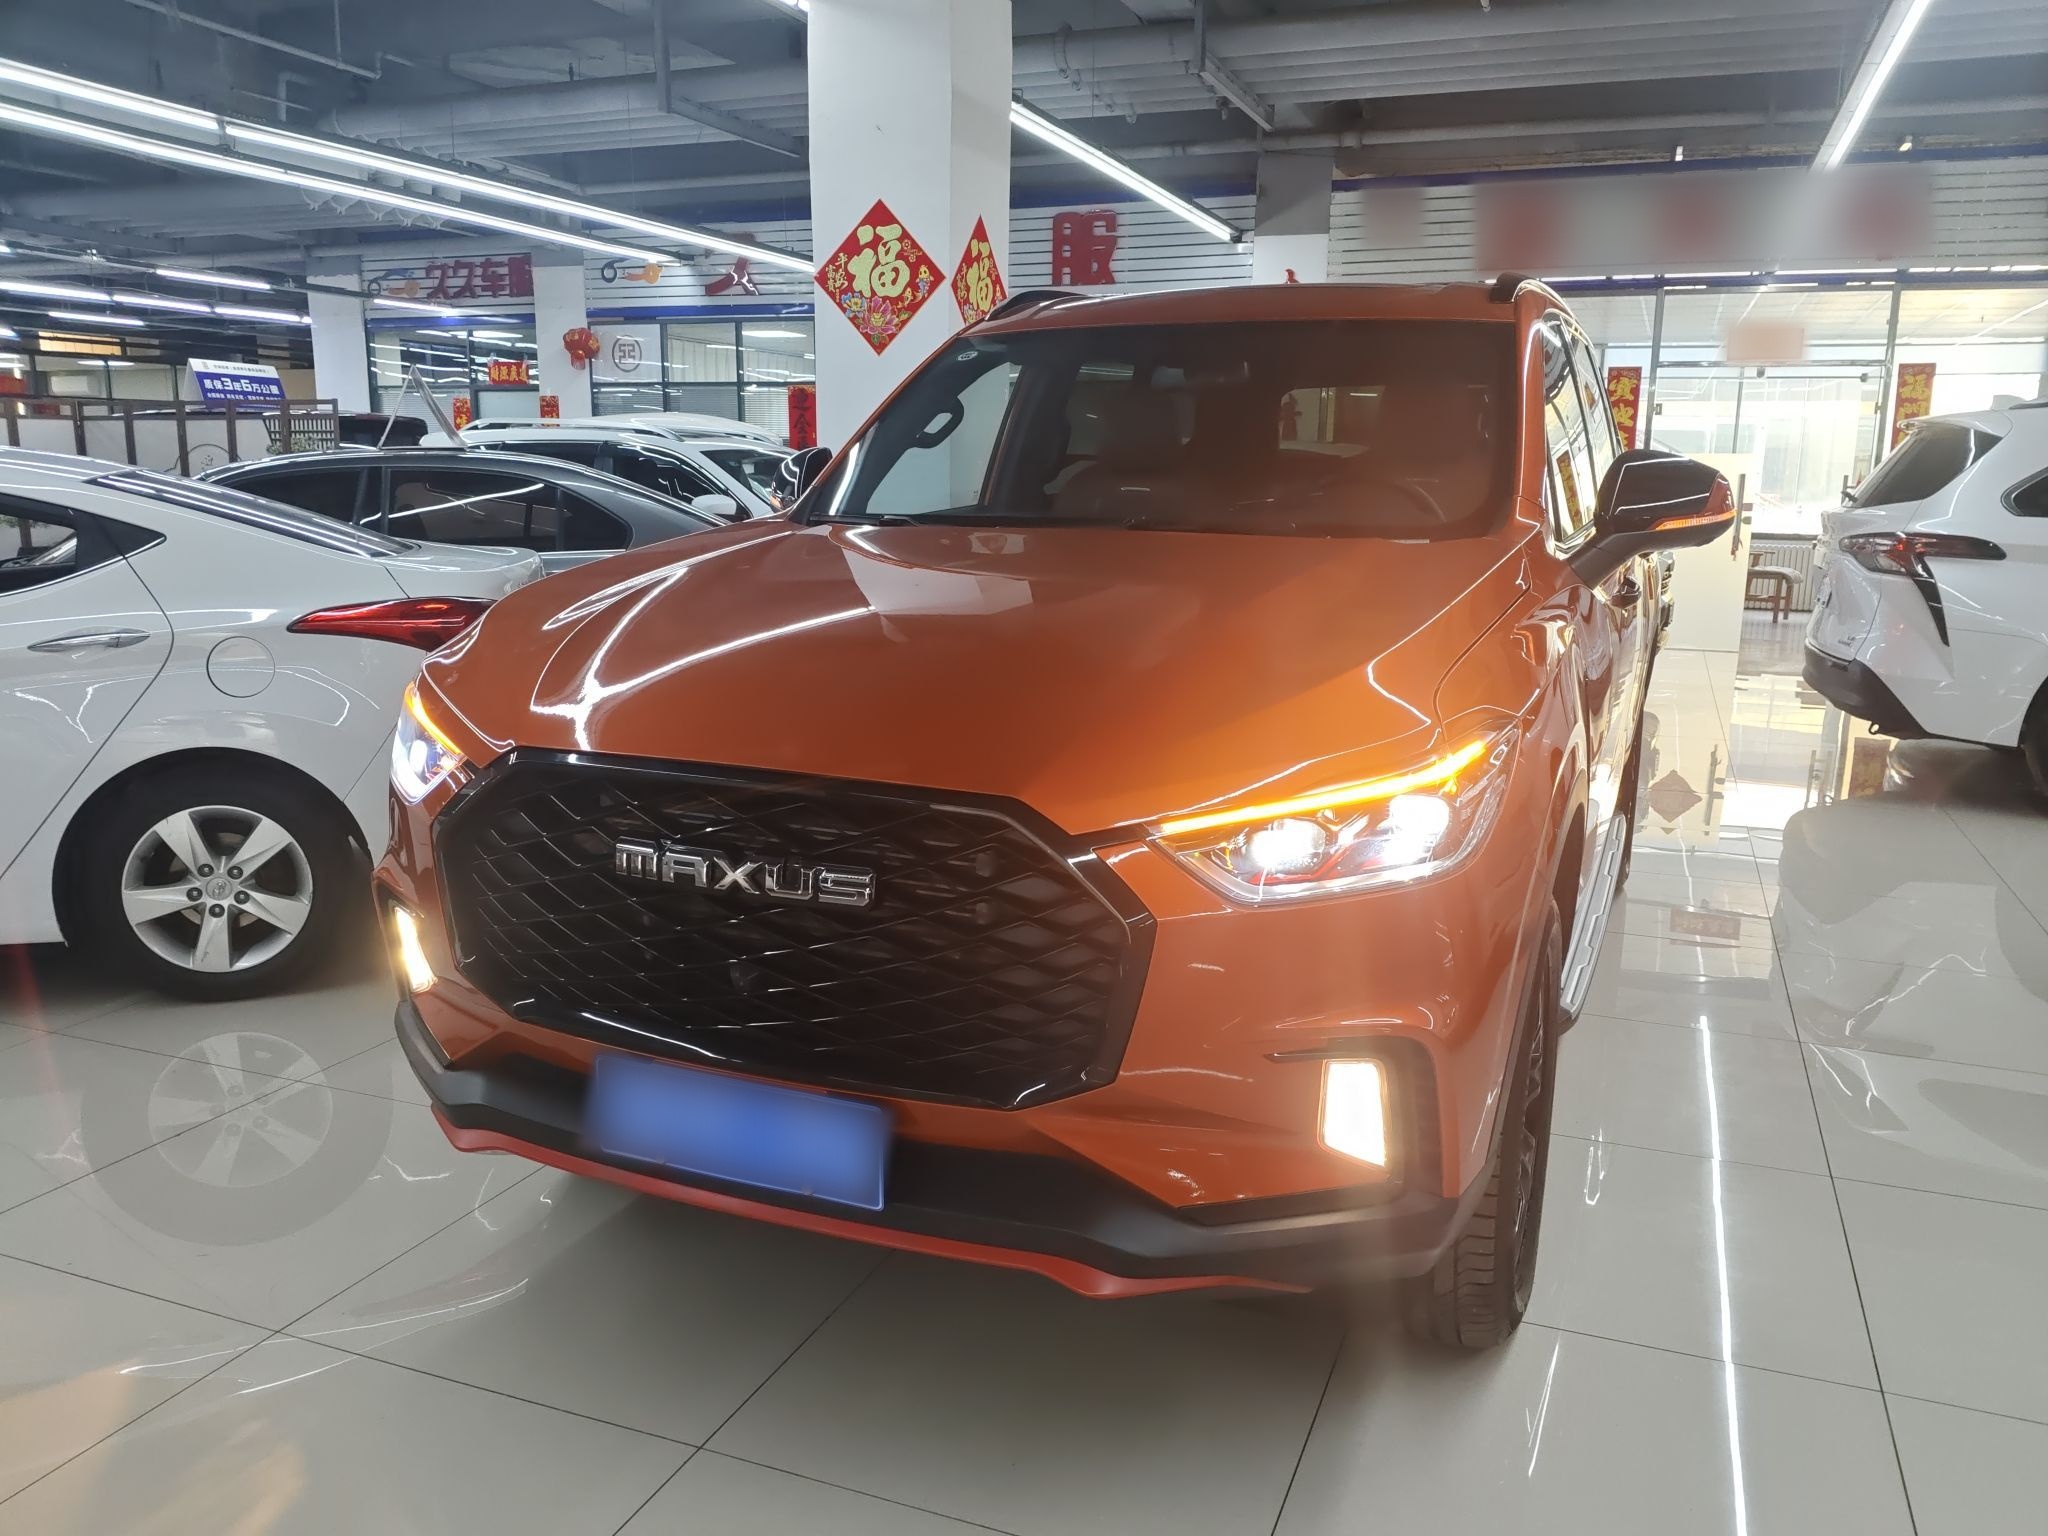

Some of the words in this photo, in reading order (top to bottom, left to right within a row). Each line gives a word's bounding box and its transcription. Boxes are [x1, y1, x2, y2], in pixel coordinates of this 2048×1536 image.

[847, 223, 911, 298] 福
[966, 238, 993, 313] 福
[615, 836, 876, 907] MAXUS
